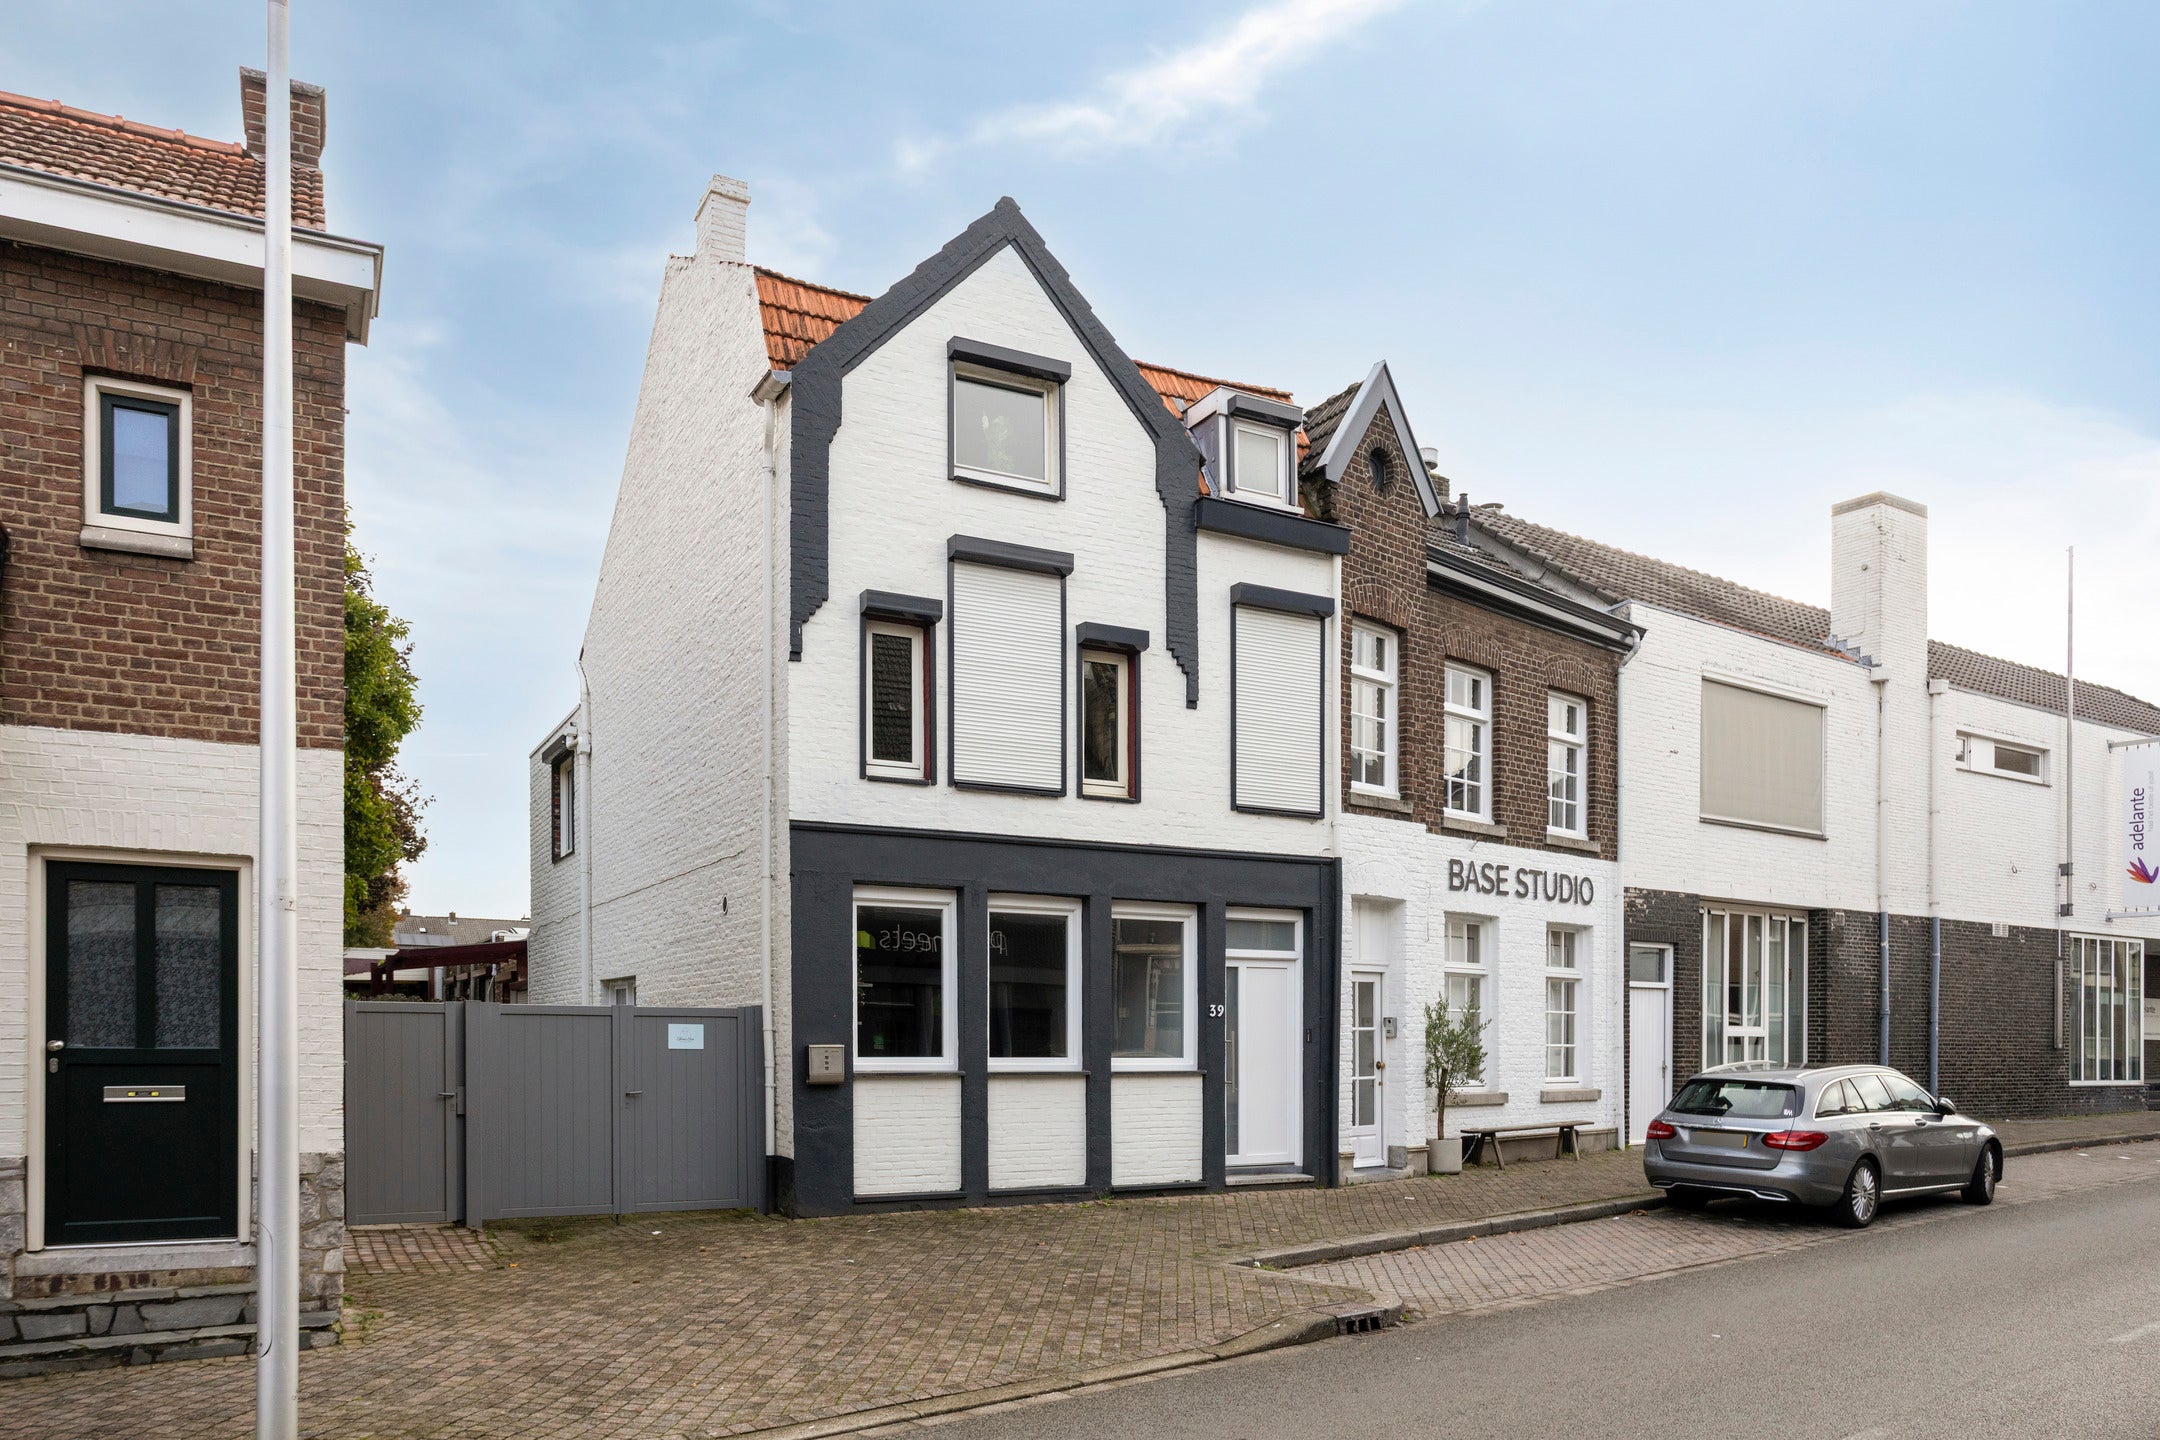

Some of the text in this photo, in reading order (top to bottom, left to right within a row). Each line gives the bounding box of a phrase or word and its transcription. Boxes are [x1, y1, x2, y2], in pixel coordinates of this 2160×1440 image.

[2129, 787, 2145, 850] adelante
[1449, 858, 1594, 906] BASE STUDIO
[1209, 1004, 1225, 1017] 39
